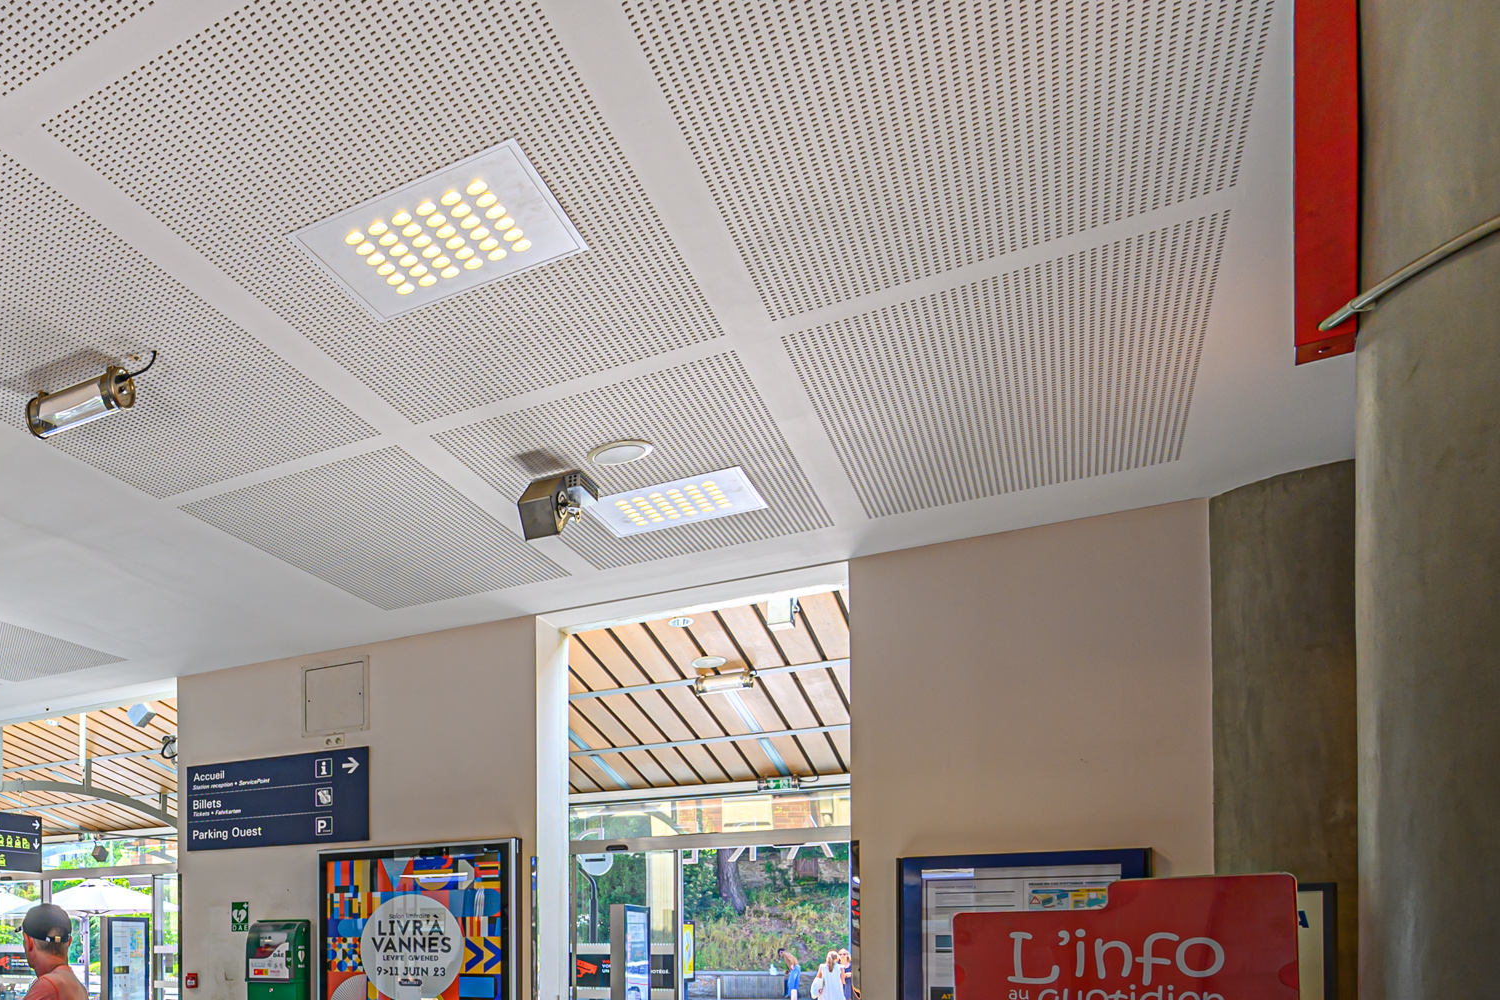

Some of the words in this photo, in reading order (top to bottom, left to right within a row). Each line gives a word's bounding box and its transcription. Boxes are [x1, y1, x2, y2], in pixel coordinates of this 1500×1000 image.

[193, 770, 225, 782] Accueil
[192, 799, 222, 810] Billets
[193, 828, 228, 840] Parking
[231, 826, 262, 838] Ouest
[378, 914, 444, 936] LIVR'À
[371, 937, 452, 953] VANNES
[1007, 928, 1225, 986] L'info
[403, 966, 429, 976] JUIN
[433, 966, 446, 976] 23
[1008, 989, 1029, 1000] au
